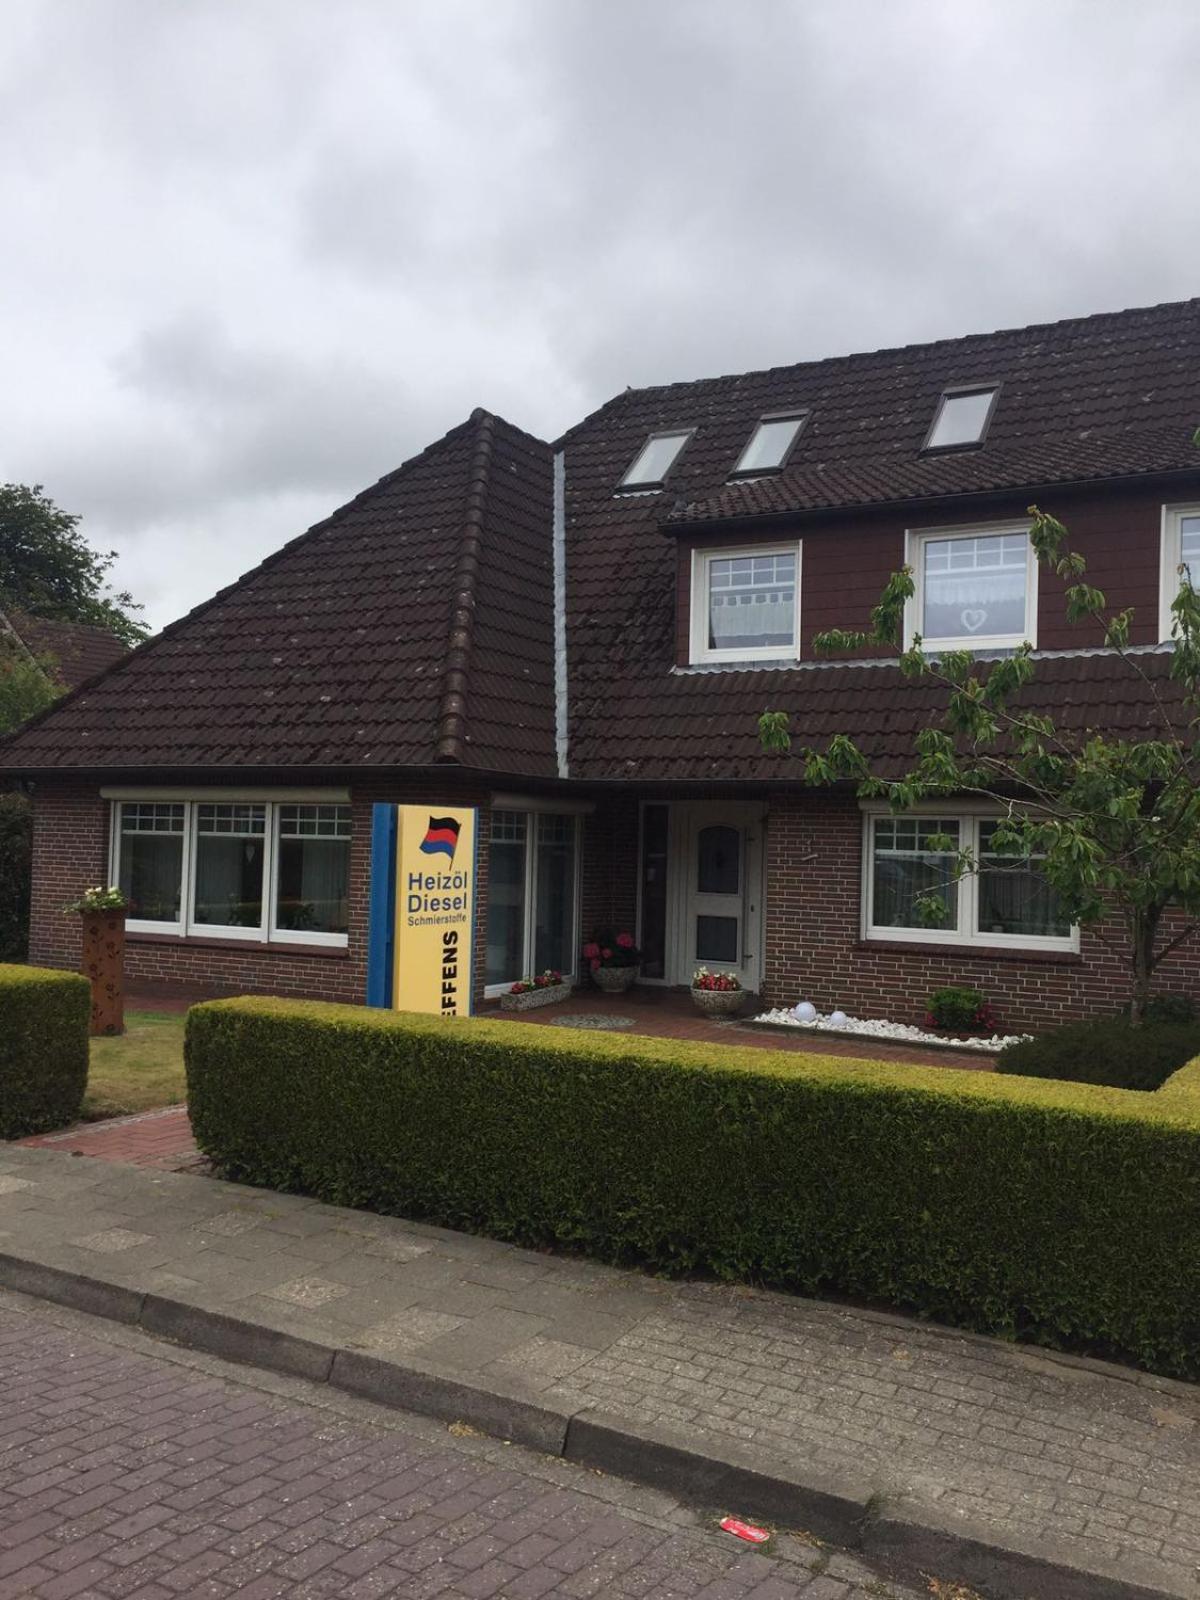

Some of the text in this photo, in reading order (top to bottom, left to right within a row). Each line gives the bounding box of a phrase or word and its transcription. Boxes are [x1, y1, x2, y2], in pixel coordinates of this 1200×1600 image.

[408, 871, 468, 891] Heizöl
[408, 892, 467, 913] Diesel
[407, 913, 467, 927] Schmierstoffe
